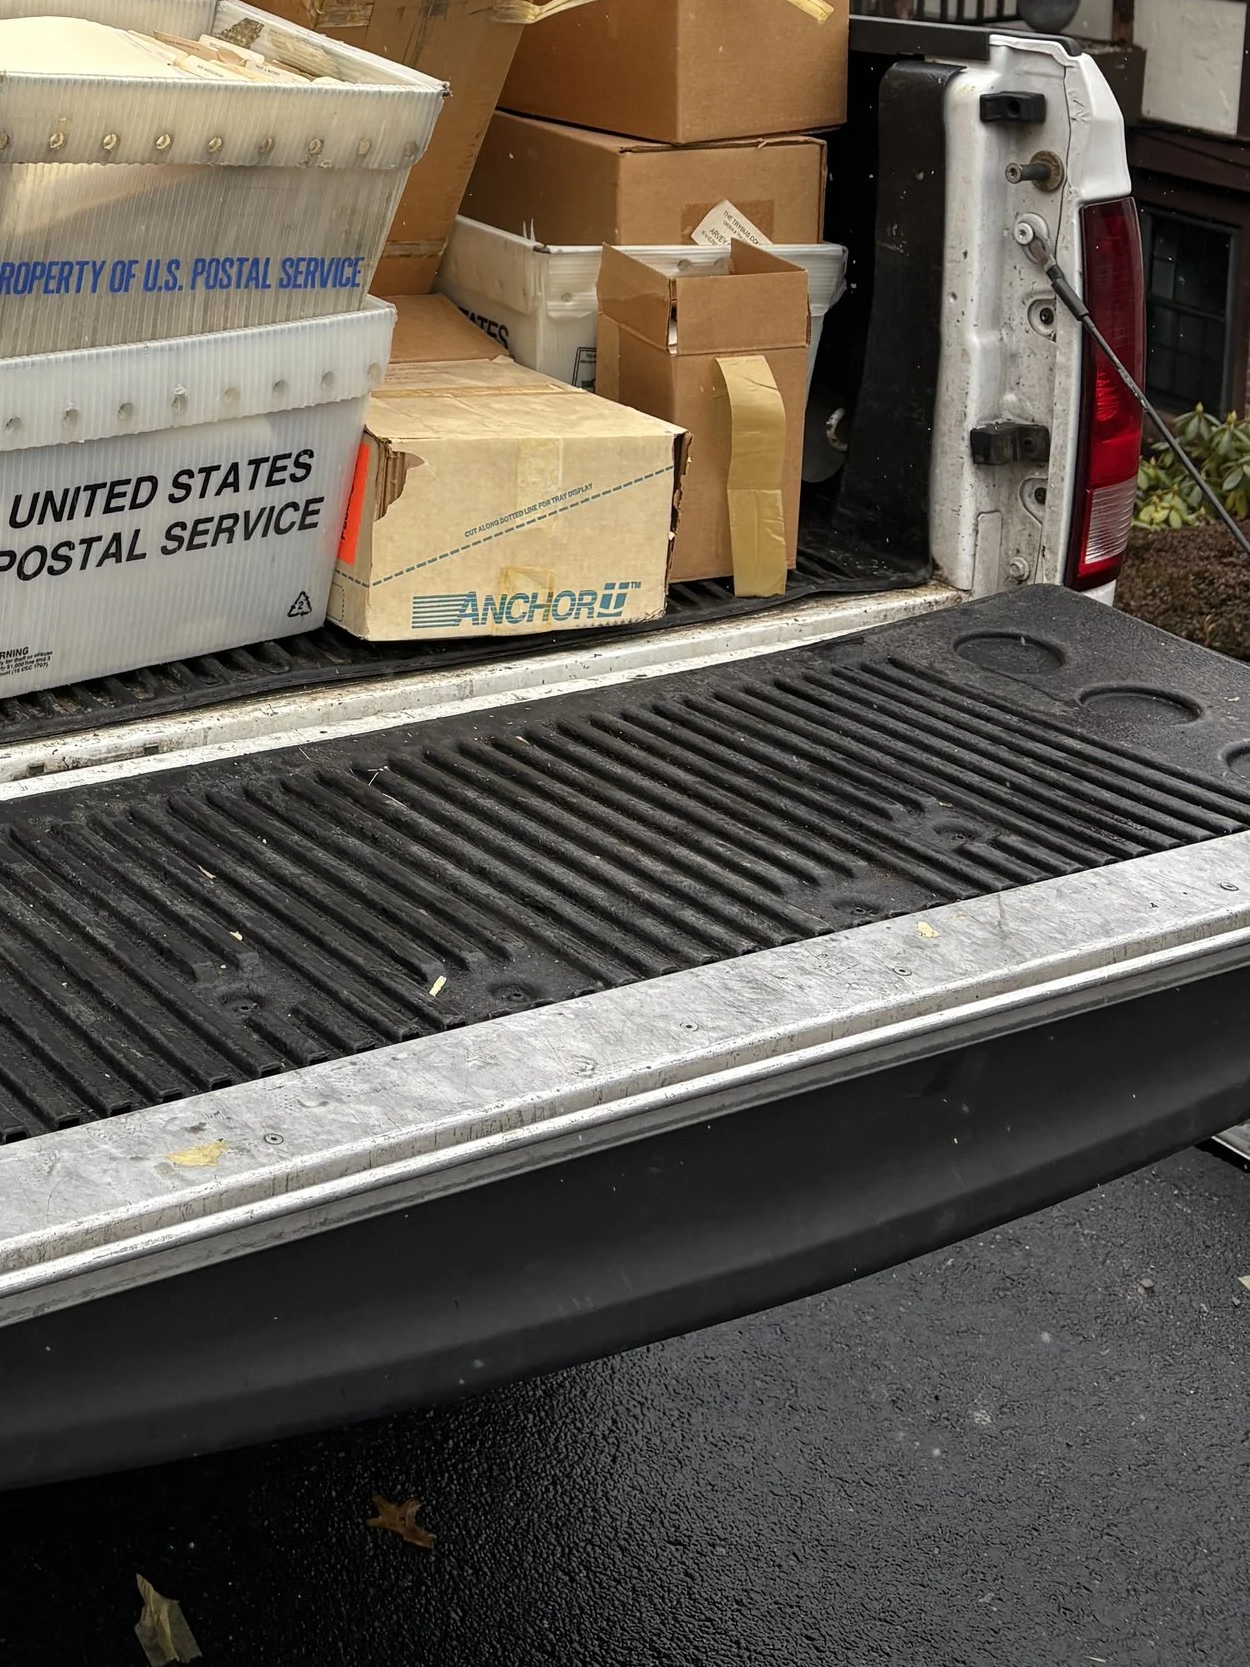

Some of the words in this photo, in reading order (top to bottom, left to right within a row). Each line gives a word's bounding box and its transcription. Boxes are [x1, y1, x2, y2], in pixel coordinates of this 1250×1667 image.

[109, 260, 139, 294] OF
[143, 259, 184, 293] U.S.
[190, 257, 271, 291] POSTAL
[278, 256, 366, 290] SERVICE
[8, 475, 159, 530] UNITED
[167, 448, 315, 504] STATES
[464, 527, 478, 538] CUT
[478, 520, 500, 533] ALONG
[500, 510, 524, 525] DOTTED
[524, 504, 538, 515] LINE
[538, 499, 551, 509] FOR
[551, 492, 568, 504] TRAY
[568, 482, 594, 499] DISPLAY
[160, 496, 325, 556] SERVICE
[456, 589, 598, 626] ANCHOR
